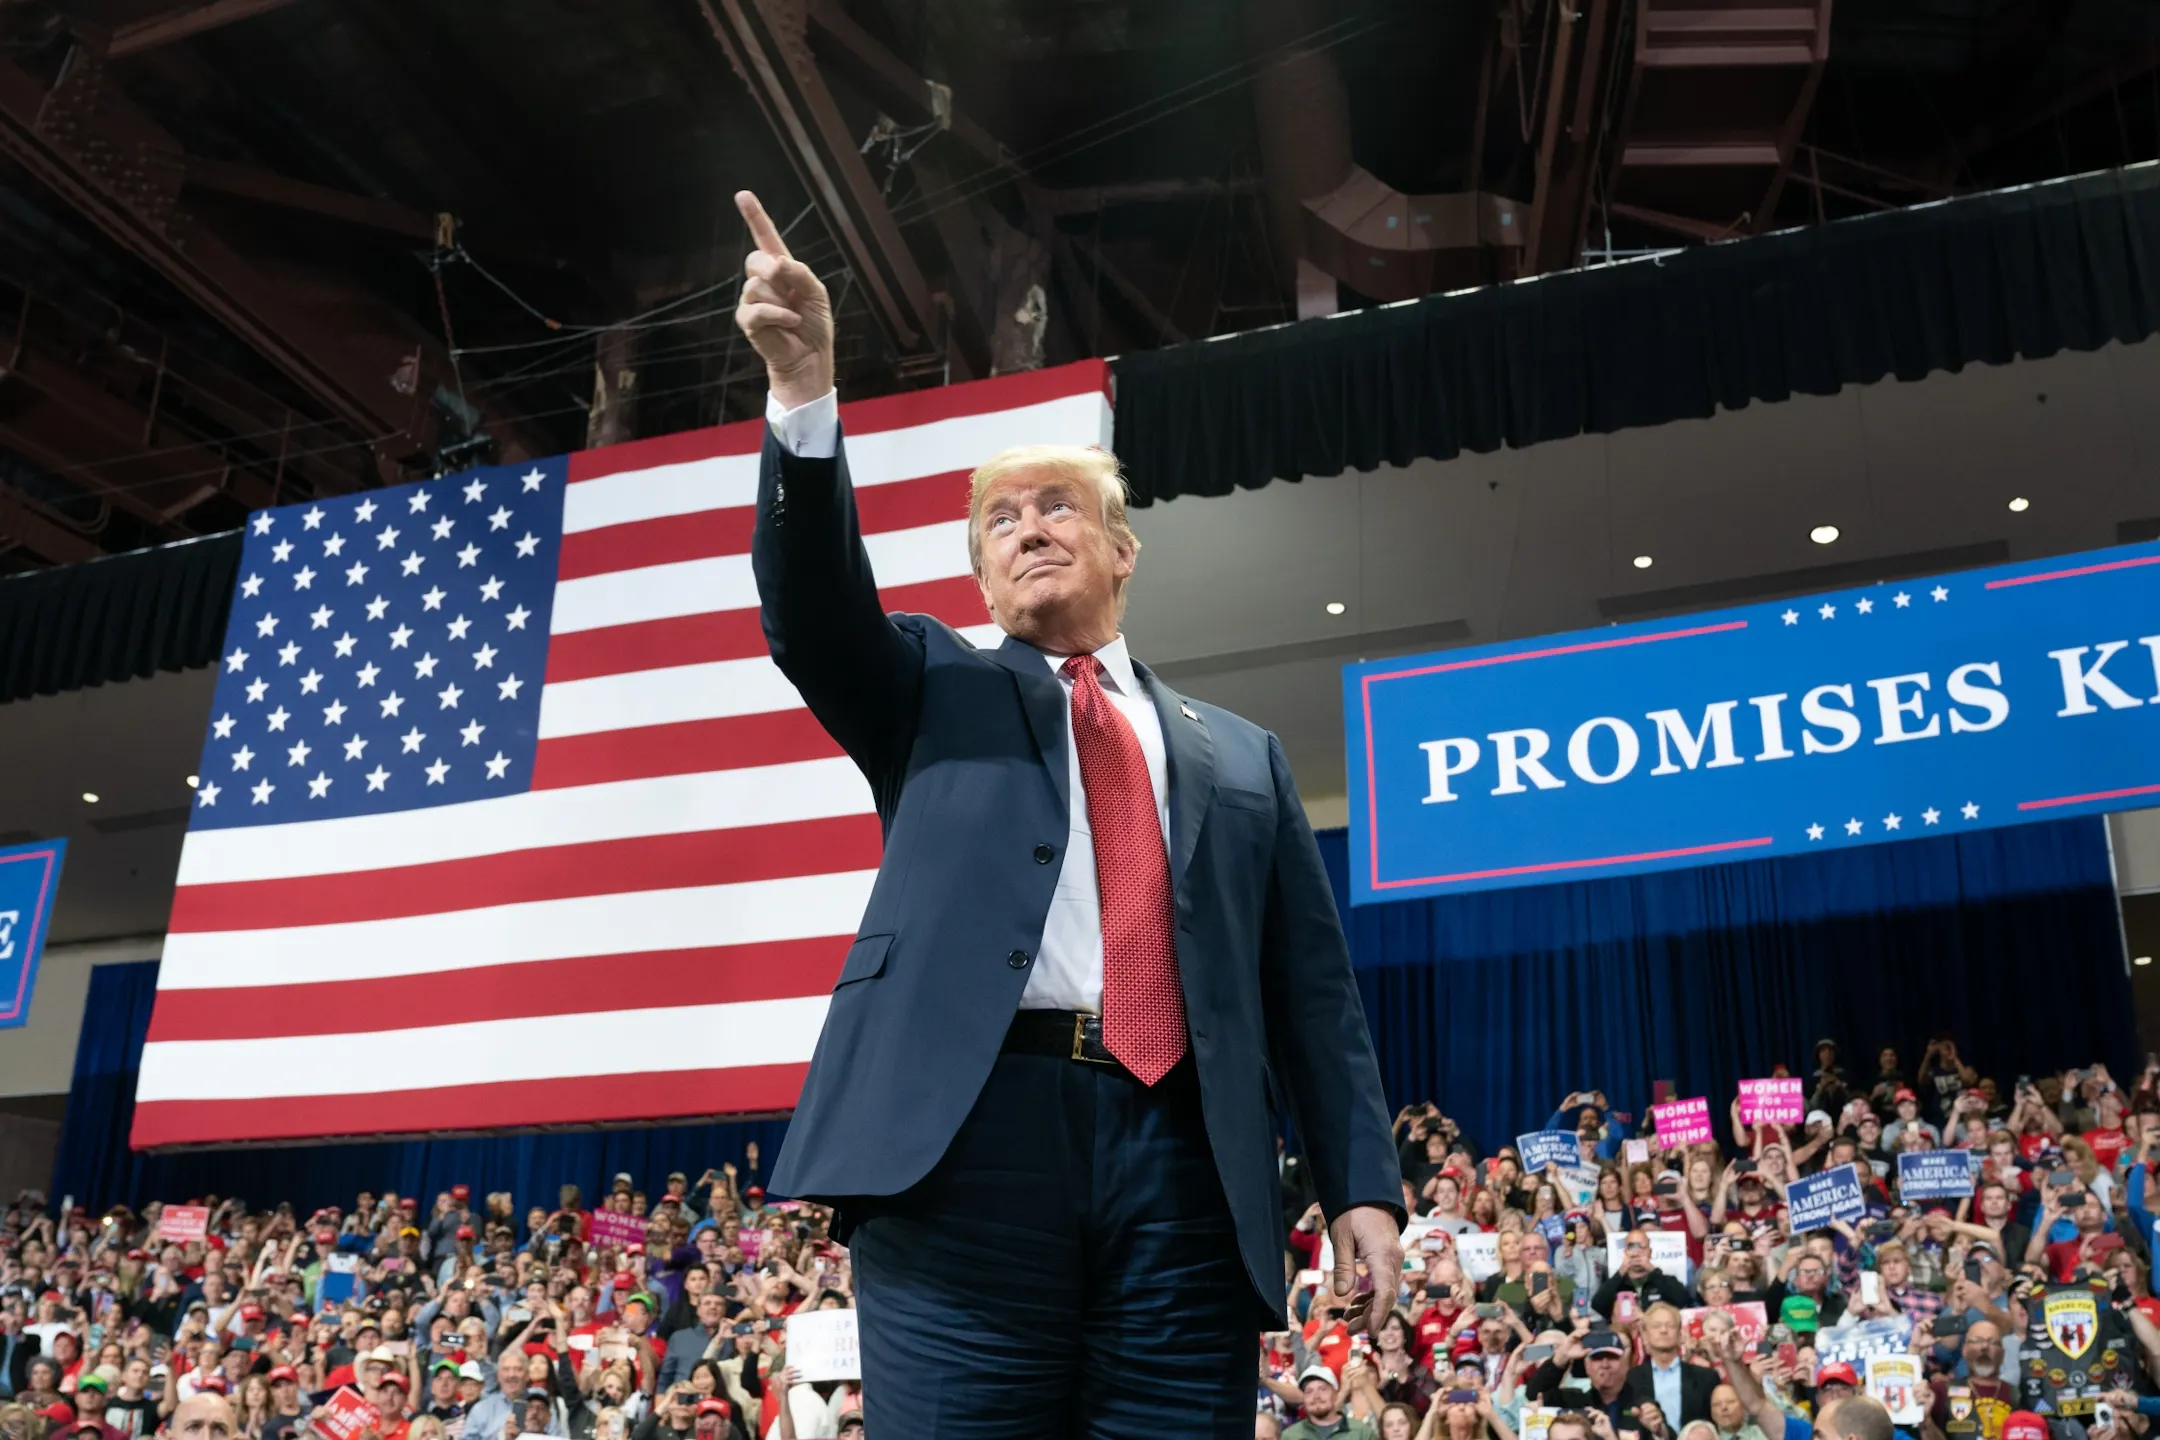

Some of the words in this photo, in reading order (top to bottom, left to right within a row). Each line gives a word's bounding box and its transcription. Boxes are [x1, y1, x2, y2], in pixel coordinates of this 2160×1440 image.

[1418, 661, 2011, 804] PROMISES
[1739, 1081, 1802, 1095] WOMEN
[1758, 1097, 1781, 1106] FOR
[1654, 1100, 1708, 1120] WOMEN
[1743, 1108, 1800, 1120] TRUMP
[1670, 1118, 1691, 1129] FOR
[1660, 1127, 1709, 1145] TRUMP
[1524, 1142, 1578, 1157] AMERICA
[1921, 1156, 1947, 1165] MAKE
[1903, 1166, 1969, 1181] AMERICA
[1808, 1177, 1833, 1193] MAKE
[1792, 1183, 1859, 1214] AMERICA
[1791, 1205, 1831, 1225] STRONG
[1831, 1197, 1861, 1213] AGAIN
